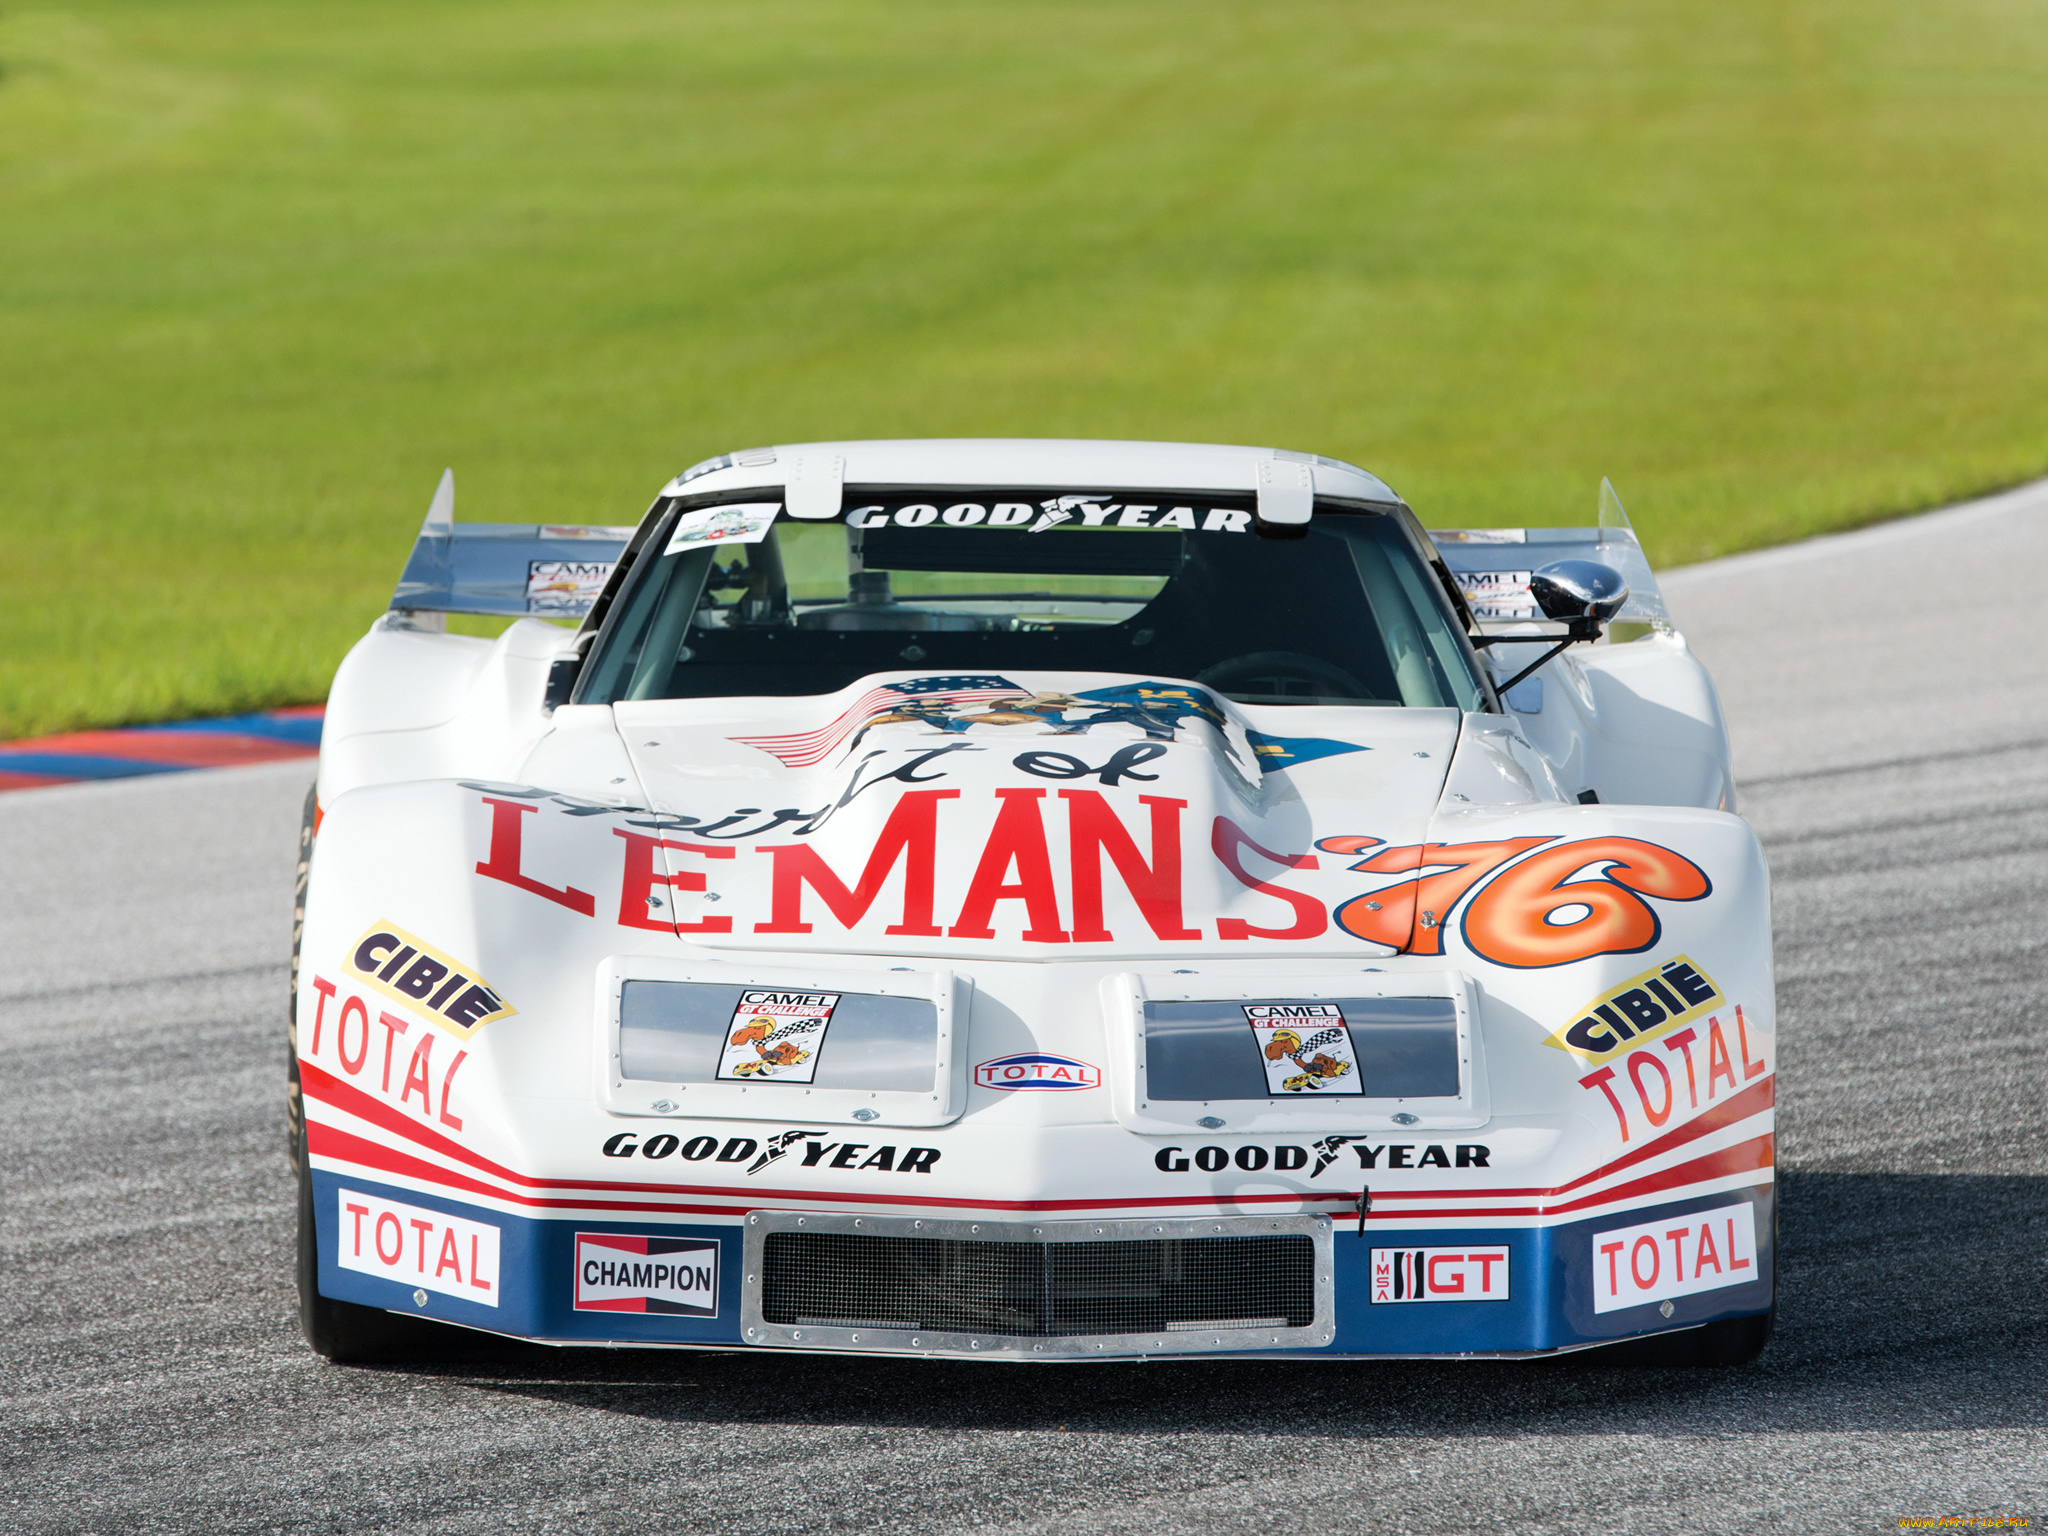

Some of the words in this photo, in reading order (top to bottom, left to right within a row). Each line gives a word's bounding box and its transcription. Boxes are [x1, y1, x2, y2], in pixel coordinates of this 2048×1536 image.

[535, 562, 615, 575] CAME
[1453, 572, 1530, 584] AMEL
[1012, 743, 1168, 787] of
[740, 1005, 759, 1014] GT
[757, 1005, 829, 1017] CHALLENGE
[744, 992, 832, 1007] CAMEL
[1248, 1006, 1338, 1018] CAMEL
[1253, 1018, 1270, 1028] GT
[1271, 1018, 1340, 1028] CHALLENGE
[311, 973, 469, 1133] TOTAL
[980, 1065, 1095, 1083] TOTAL
[1577, 1004, 1766, 1143] TOTAL
[345, 1202, 491, 1291] TOTAL
[1600, 1218, 1750, 1296] TOTAL
[583, 1260, 712, 1292] CHAMPION
[1427, 1254, 1504, 1294] GT
